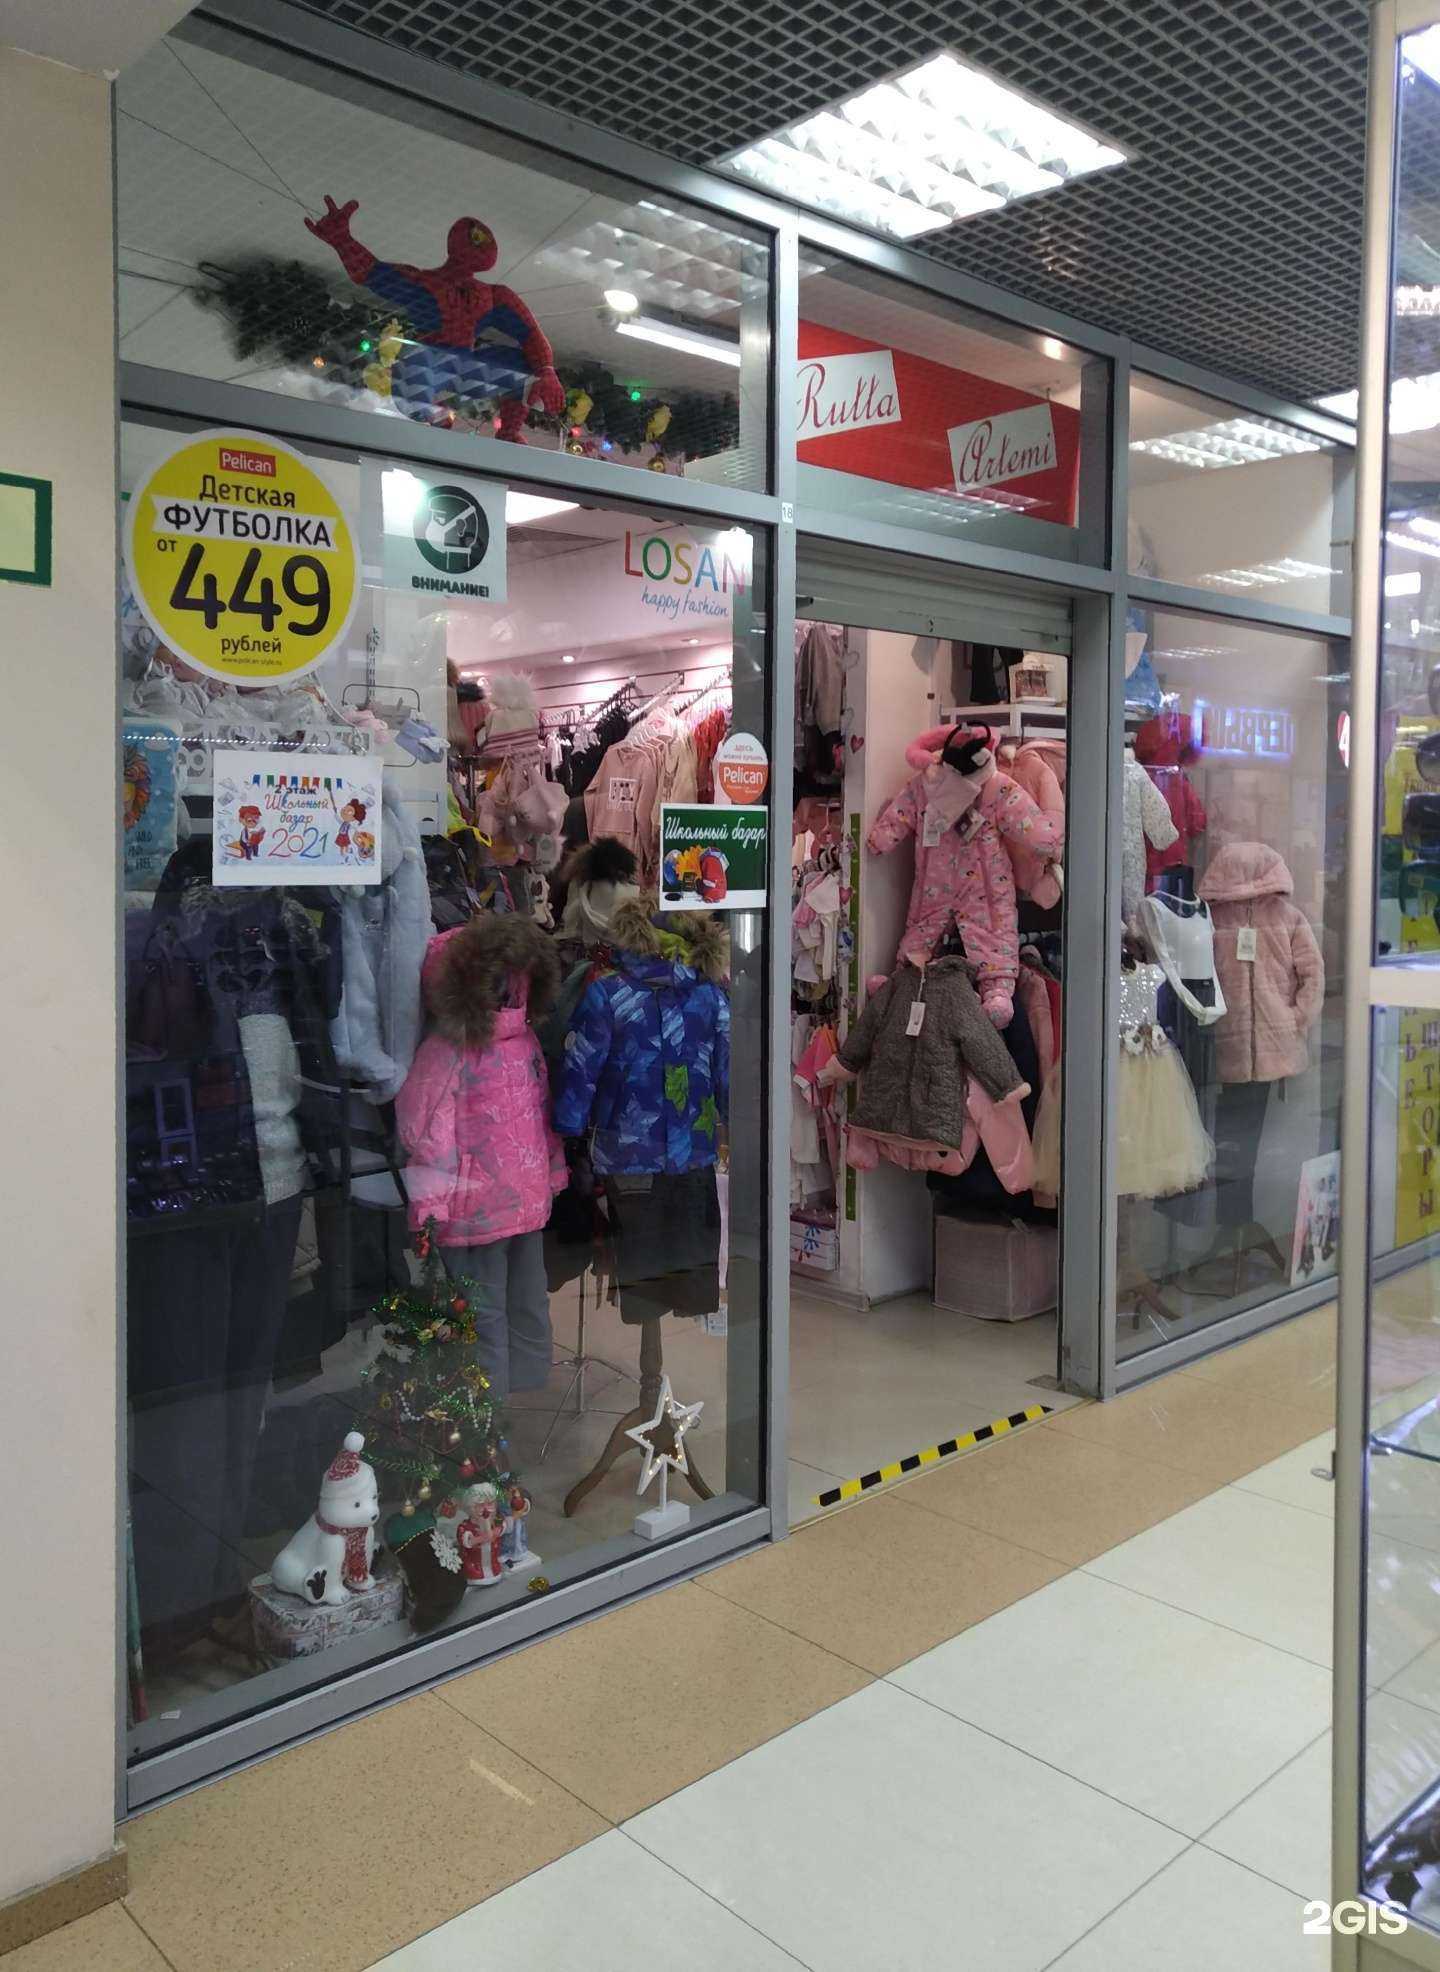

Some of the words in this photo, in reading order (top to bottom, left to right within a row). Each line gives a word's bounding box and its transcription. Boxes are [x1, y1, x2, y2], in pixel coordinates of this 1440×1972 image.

[221, 453, 273, 473] Pelican
[958, 420, 1052, 485] Artemi
[199, 474, 296, 509] Детская
[163, 503, 331, 548] ФУТБОЛКА
[624, 529, 746, 596] LOSAN
[156, 538, 178, 553] от
[169, 542, 331, 637] 449
[411, 575, 490, 598] ВНИМАНИЕ!
[641, 586, 681, 620] happy
[682, 588, 730, 618] fashion
[221, 636, 282, 655] рублей
[274, 784, 282, 794] 2
[286, 786, 317, 796] этаж
[723, 766, 763, 785] Pelican
[280, 810, 314, 833] базар
[664, 815, 729, 841] Школьный
[731, 816, 767, 849] базар
[267, 827, 329, 858] 2021
